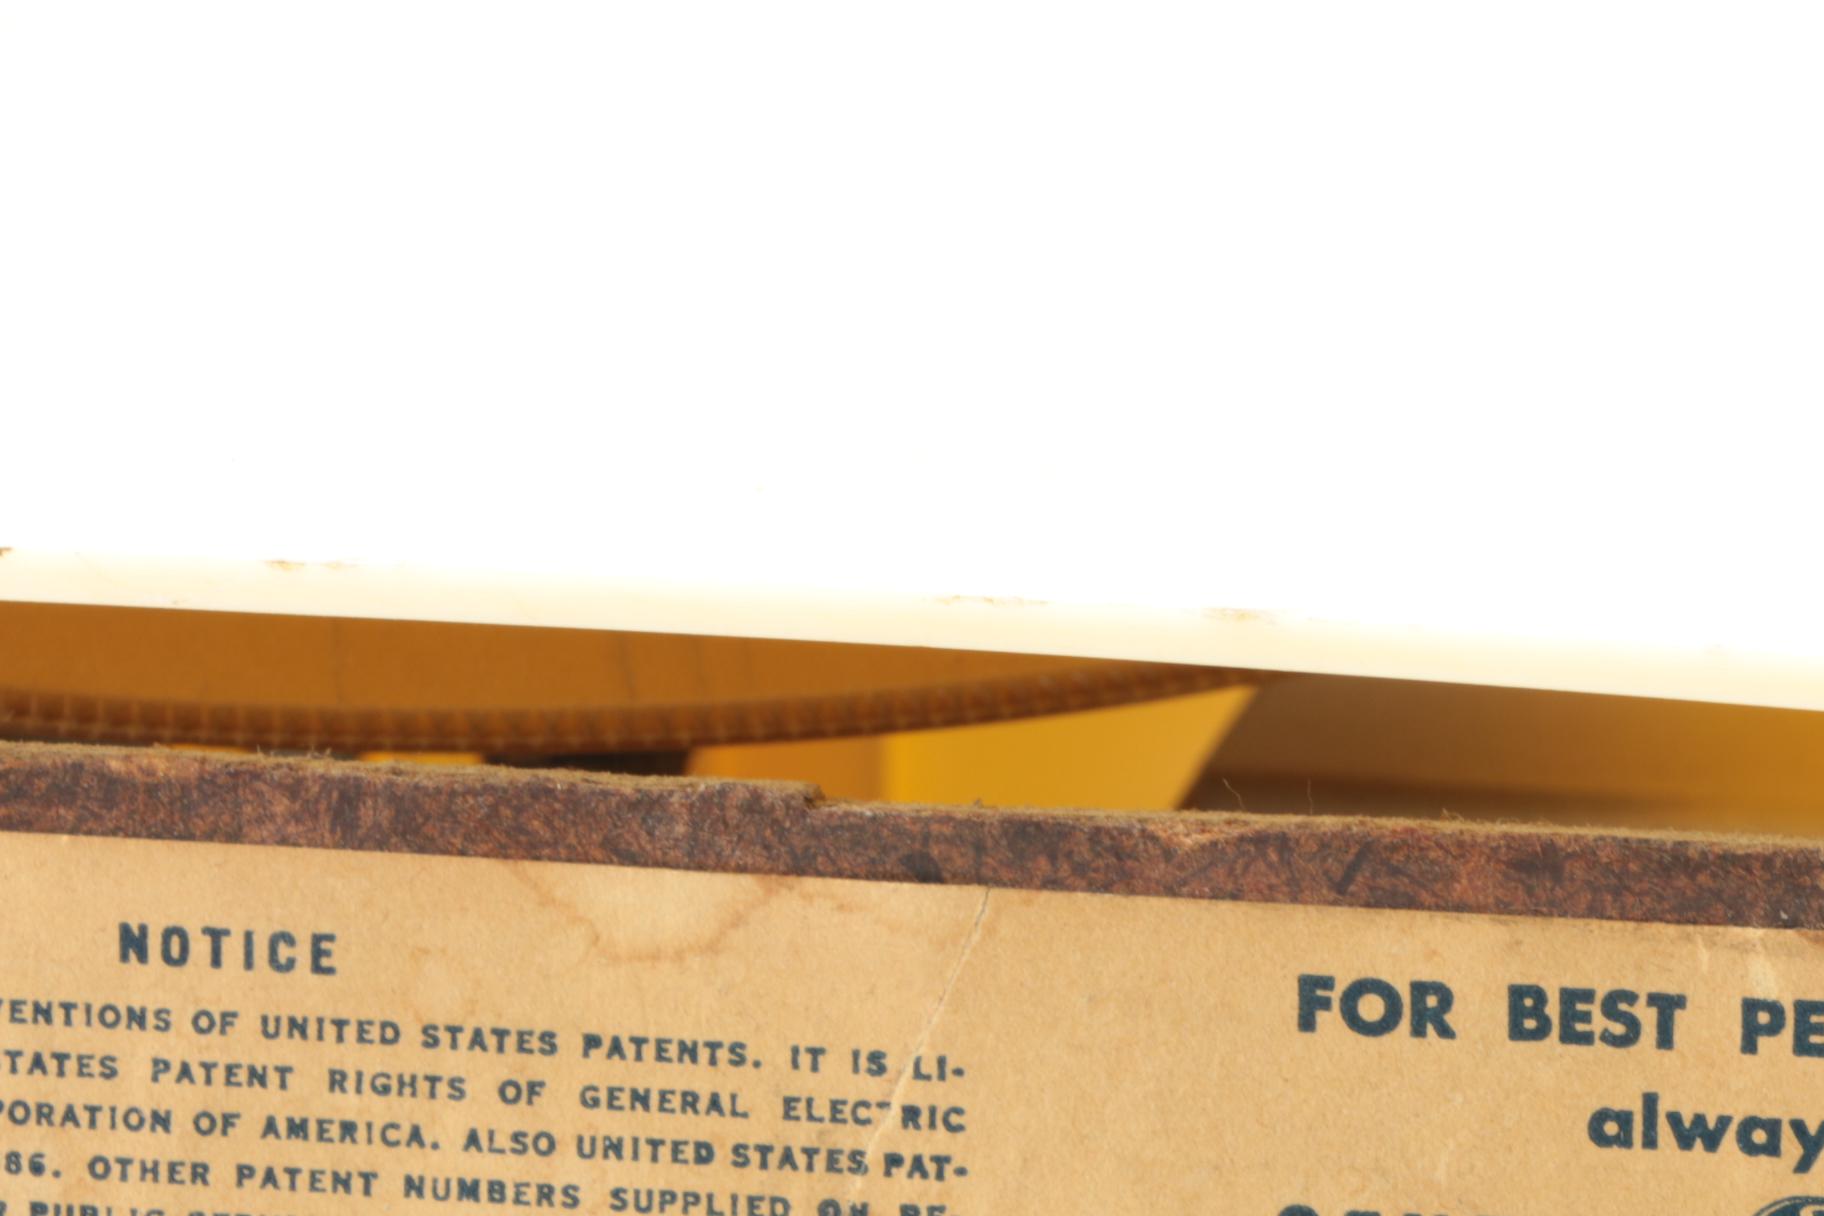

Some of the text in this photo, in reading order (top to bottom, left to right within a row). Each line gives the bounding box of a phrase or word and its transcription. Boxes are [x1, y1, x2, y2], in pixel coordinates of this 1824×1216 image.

[119, 921, 338, 976] NOTICE
[0, 998, 965, 1082] ENTIONS OF UNITED STATES PATENTS. IT IS LI-
[1298, 973, 1458, 1040] FOR
[1508, 983, 1688, 1051] BEST
[0, 1049, 119, 1079] TATES
[152, 1057, 294, 1090] PATENT
[329, 1068, 466, 1102] RIGHTS
[498, 1078, 546, 1106] OF
[581, 1084, 750, 1119] GENERAL
[0, 1099, 969, 1181] ORATION OF AMERICA. ALSO UNITED STATES PAT-
[89, 1154, 211, 1186] OTHER
[237, 1163, 379, 1196] PATENT
[404, 1173, 581, 1209] NUMBERS
